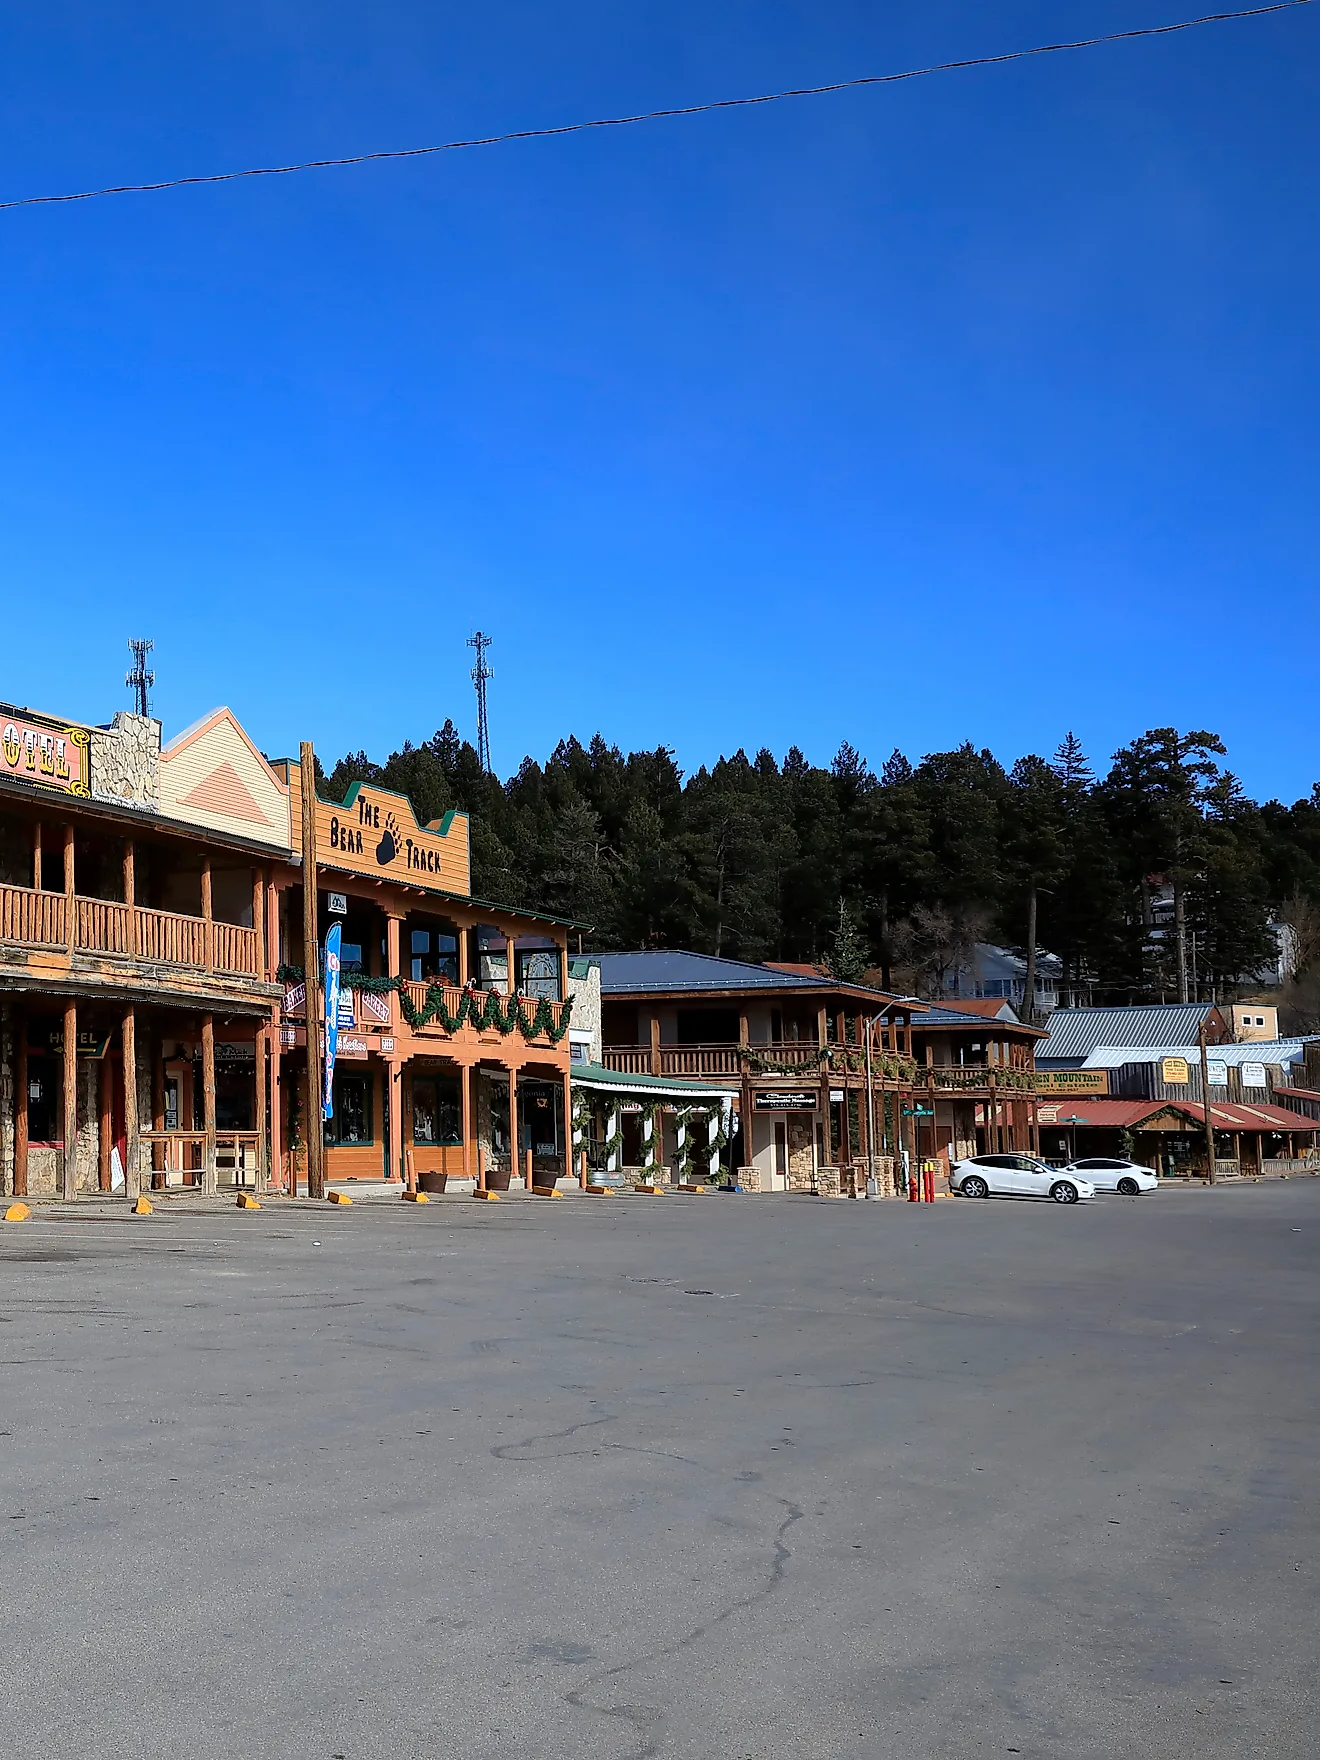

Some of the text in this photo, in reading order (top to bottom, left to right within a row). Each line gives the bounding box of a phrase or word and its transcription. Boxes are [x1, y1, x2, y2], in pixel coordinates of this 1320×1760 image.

[357, 794, 380, 829] THE
[330, 816, 442, 874] BEAR TRACK
[50, 1032, 97, 1043] HEL
[1053, 1072, 1104, 1083] MOUNTAIN
